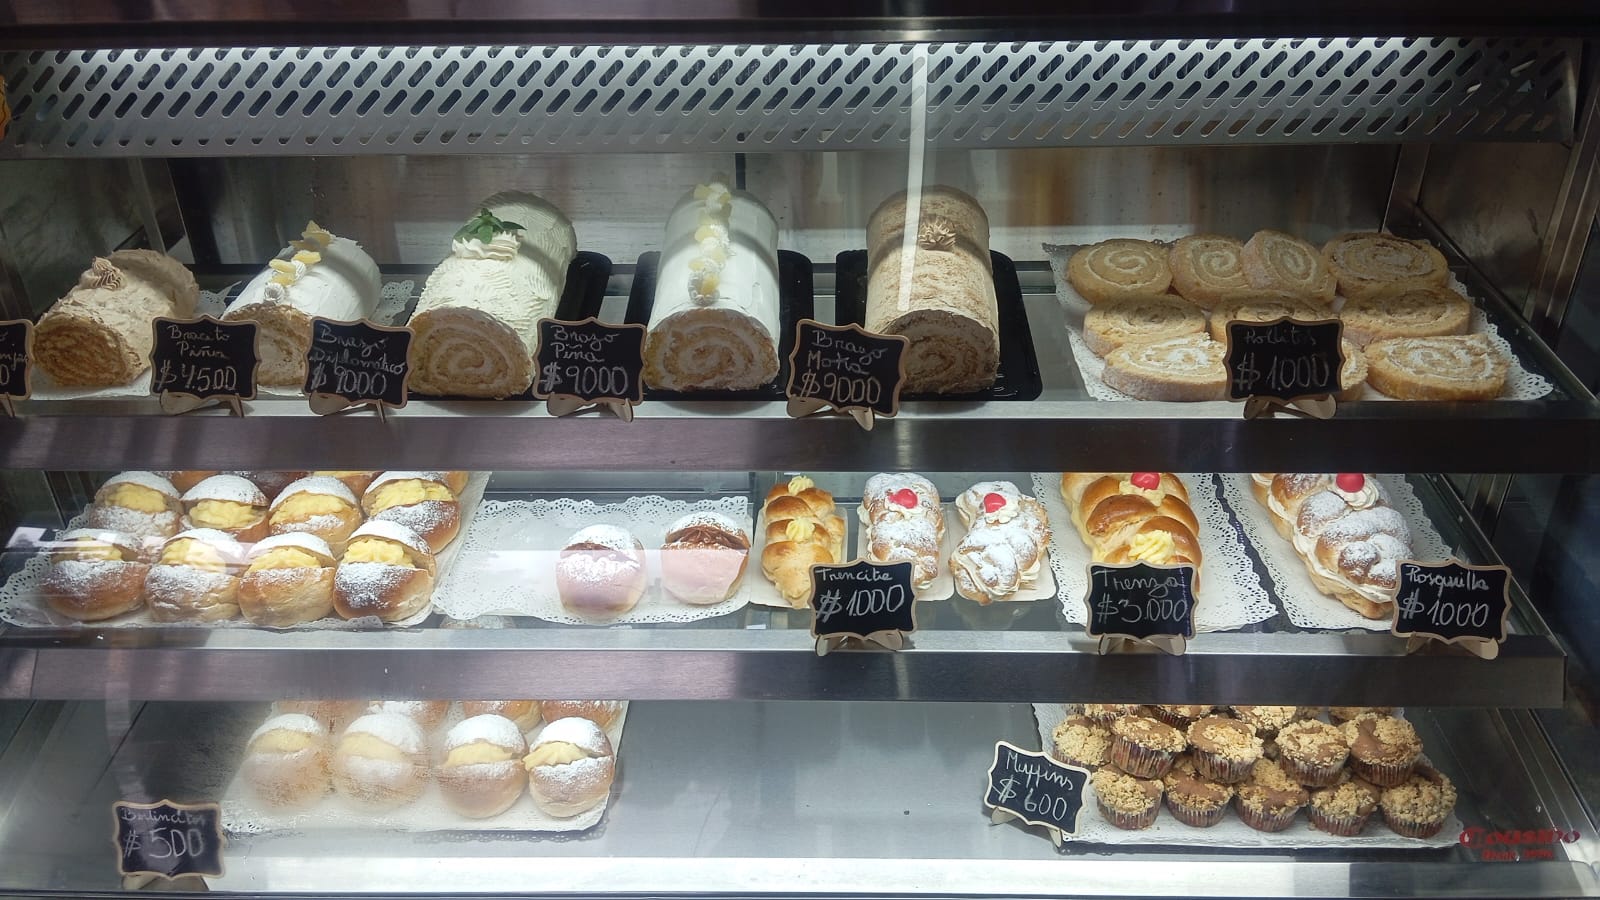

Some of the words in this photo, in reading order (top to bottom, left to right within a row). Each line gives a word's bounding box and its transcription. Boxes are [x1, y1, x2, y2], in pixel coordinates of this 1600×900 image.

[549, 341, 606, 363] Piña
[1091, 567, 1185, 599] Trenza
[1005, 750, 1074, 791] Muffins
